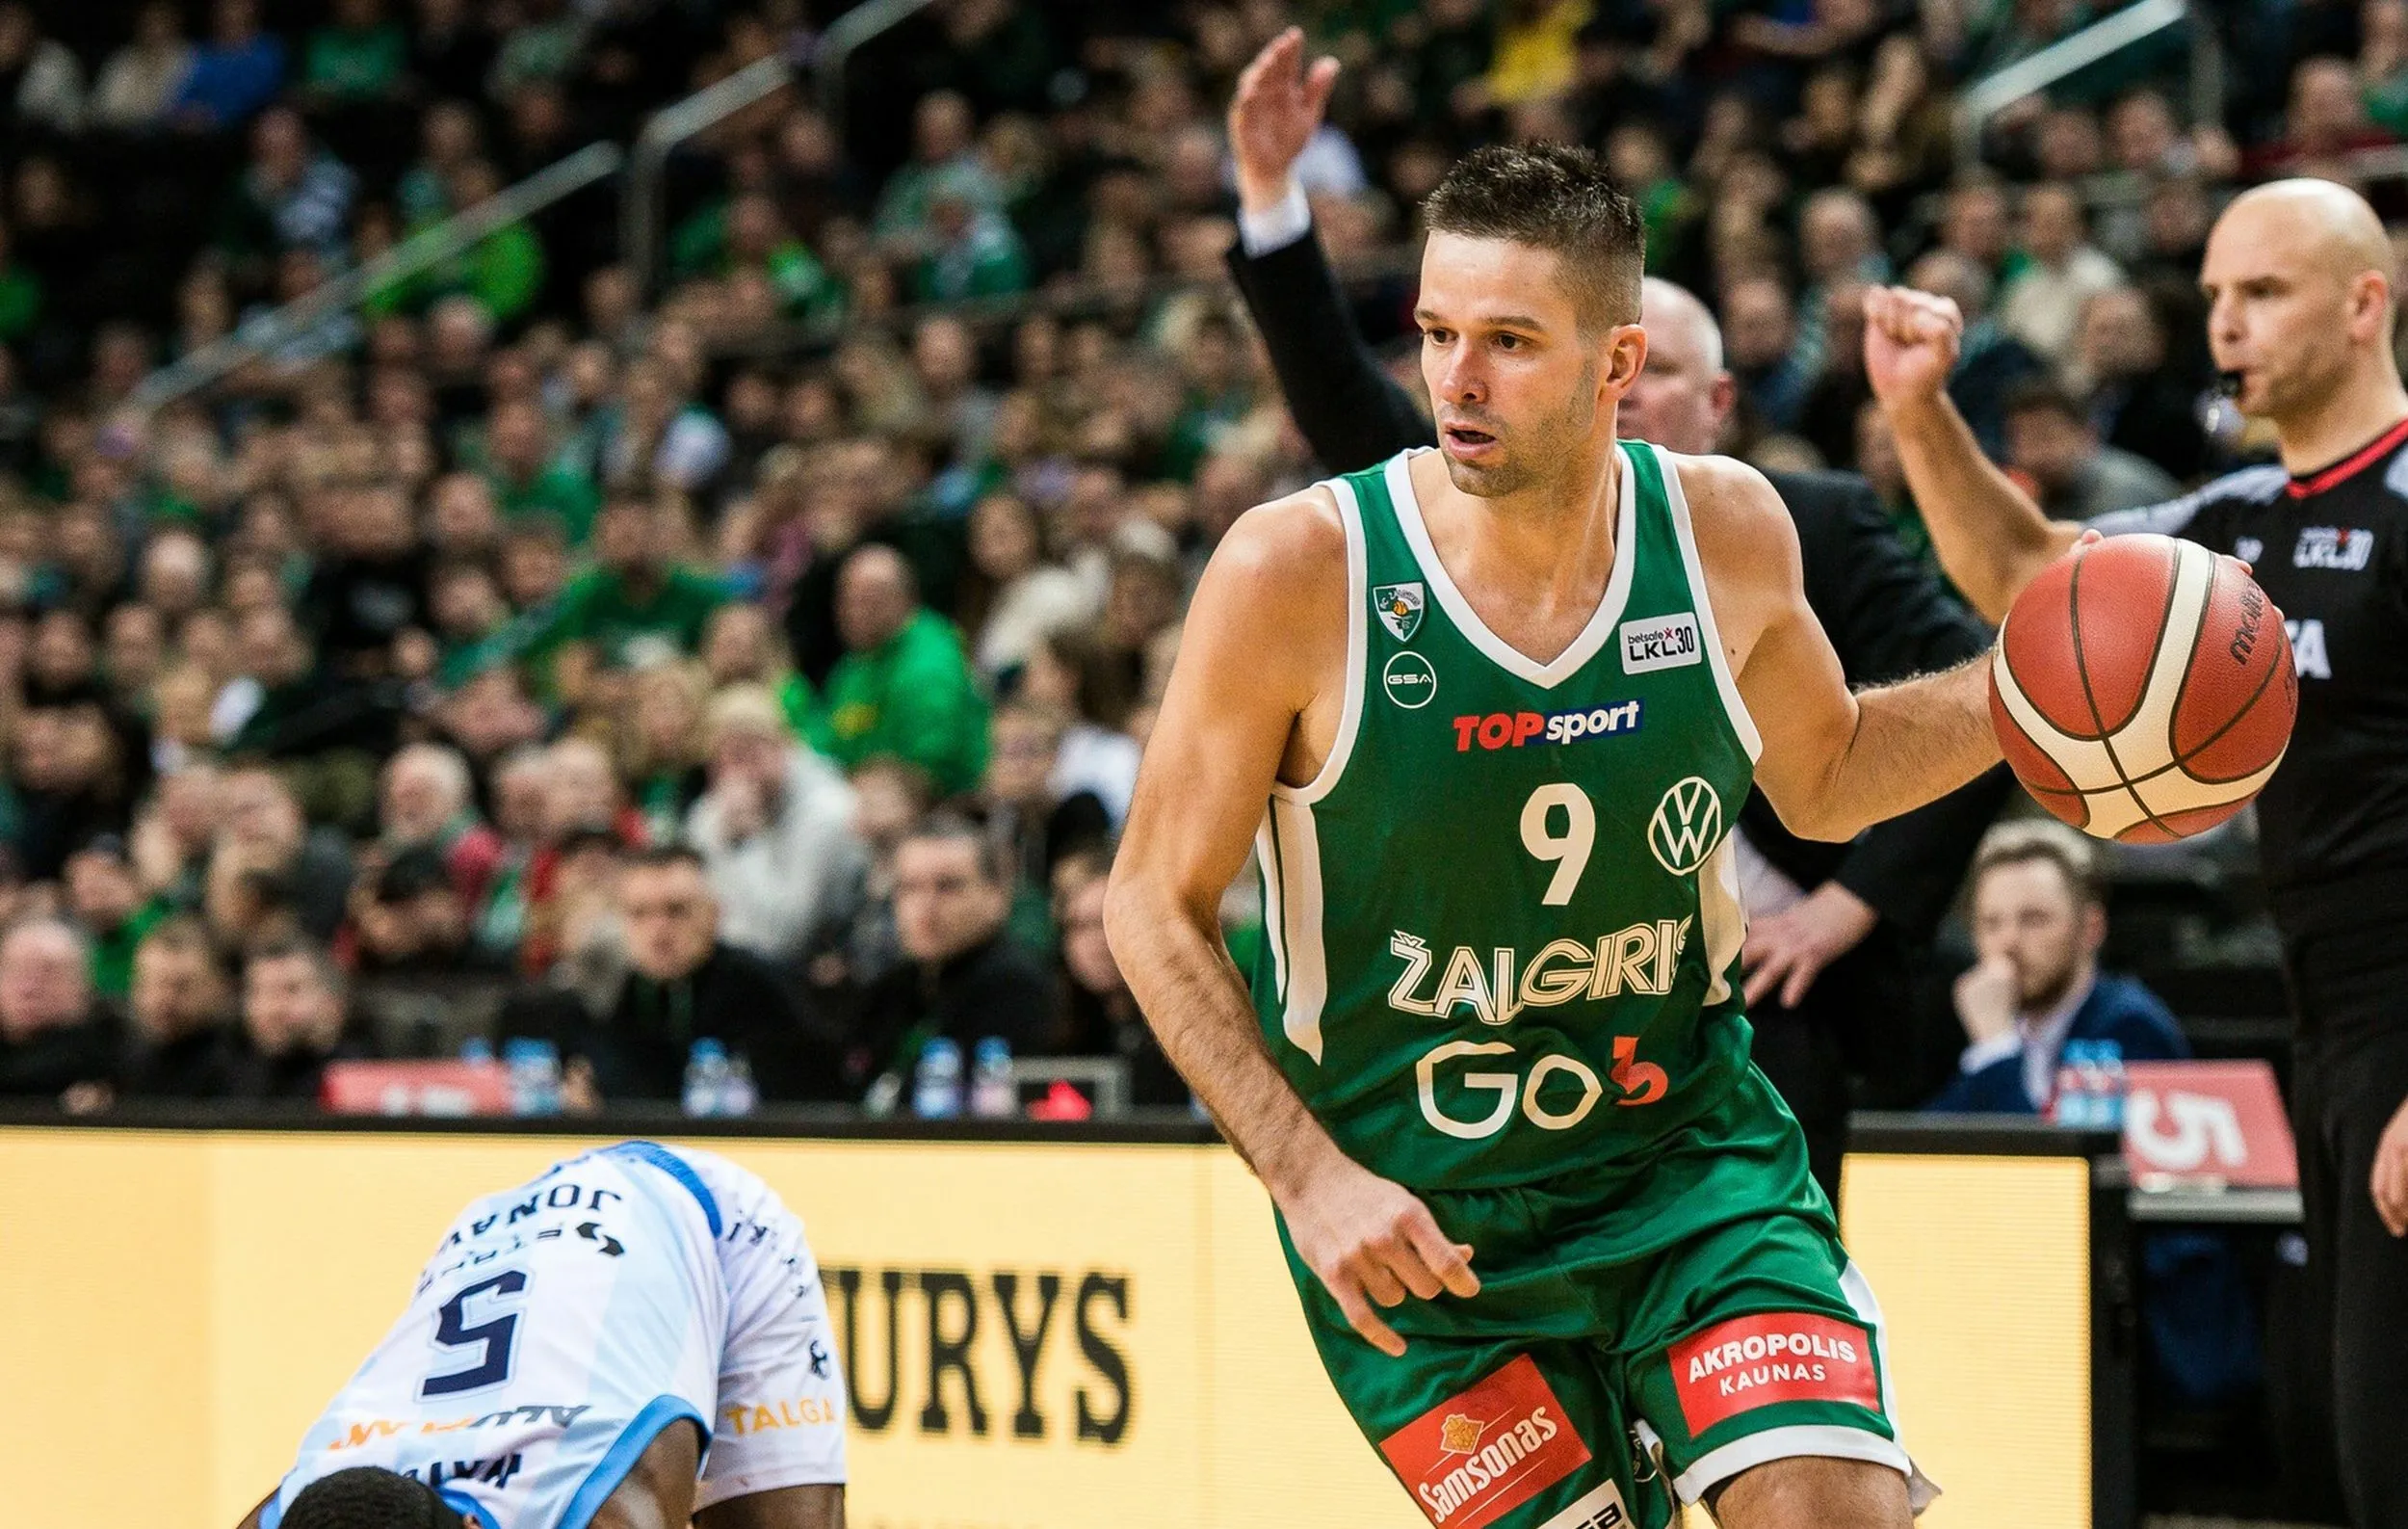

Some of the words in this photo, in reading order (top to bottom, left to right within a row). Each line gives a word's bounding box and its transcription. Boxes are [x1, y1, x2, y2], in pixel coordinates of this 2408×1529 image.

[1387, 672, 1433, 685] GSA
[1628, 630, 1664, 645] betsafe
[1520, 782, 1596, 906] 9
[423, 1270, 527, 1398] 5
[819, 1269, 1132, 1445] URYS
[1688, 1331, 1859, 1384] AKROPOLIS
[1719, 1363, 1828, 1397] KAUNAS
[1417, 1405, 1559, 1524] Samsonas
